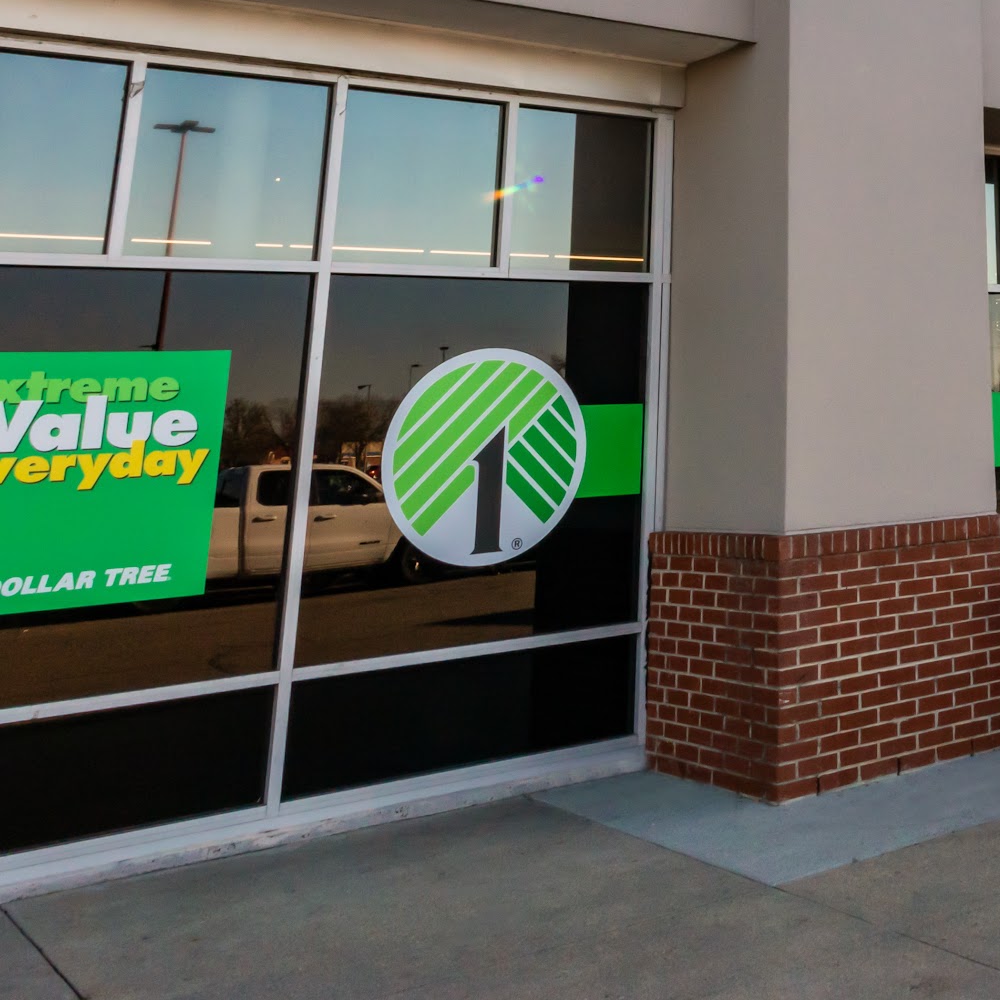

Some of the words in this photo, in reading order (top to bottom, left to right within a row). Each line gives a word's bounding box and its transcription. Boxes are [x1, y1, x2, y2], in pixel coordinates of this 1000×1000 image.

[0, 395, 198, 453] Value
[0, 569, 96, 597] OLLAR
[104, 563, 172, 587] TREE
